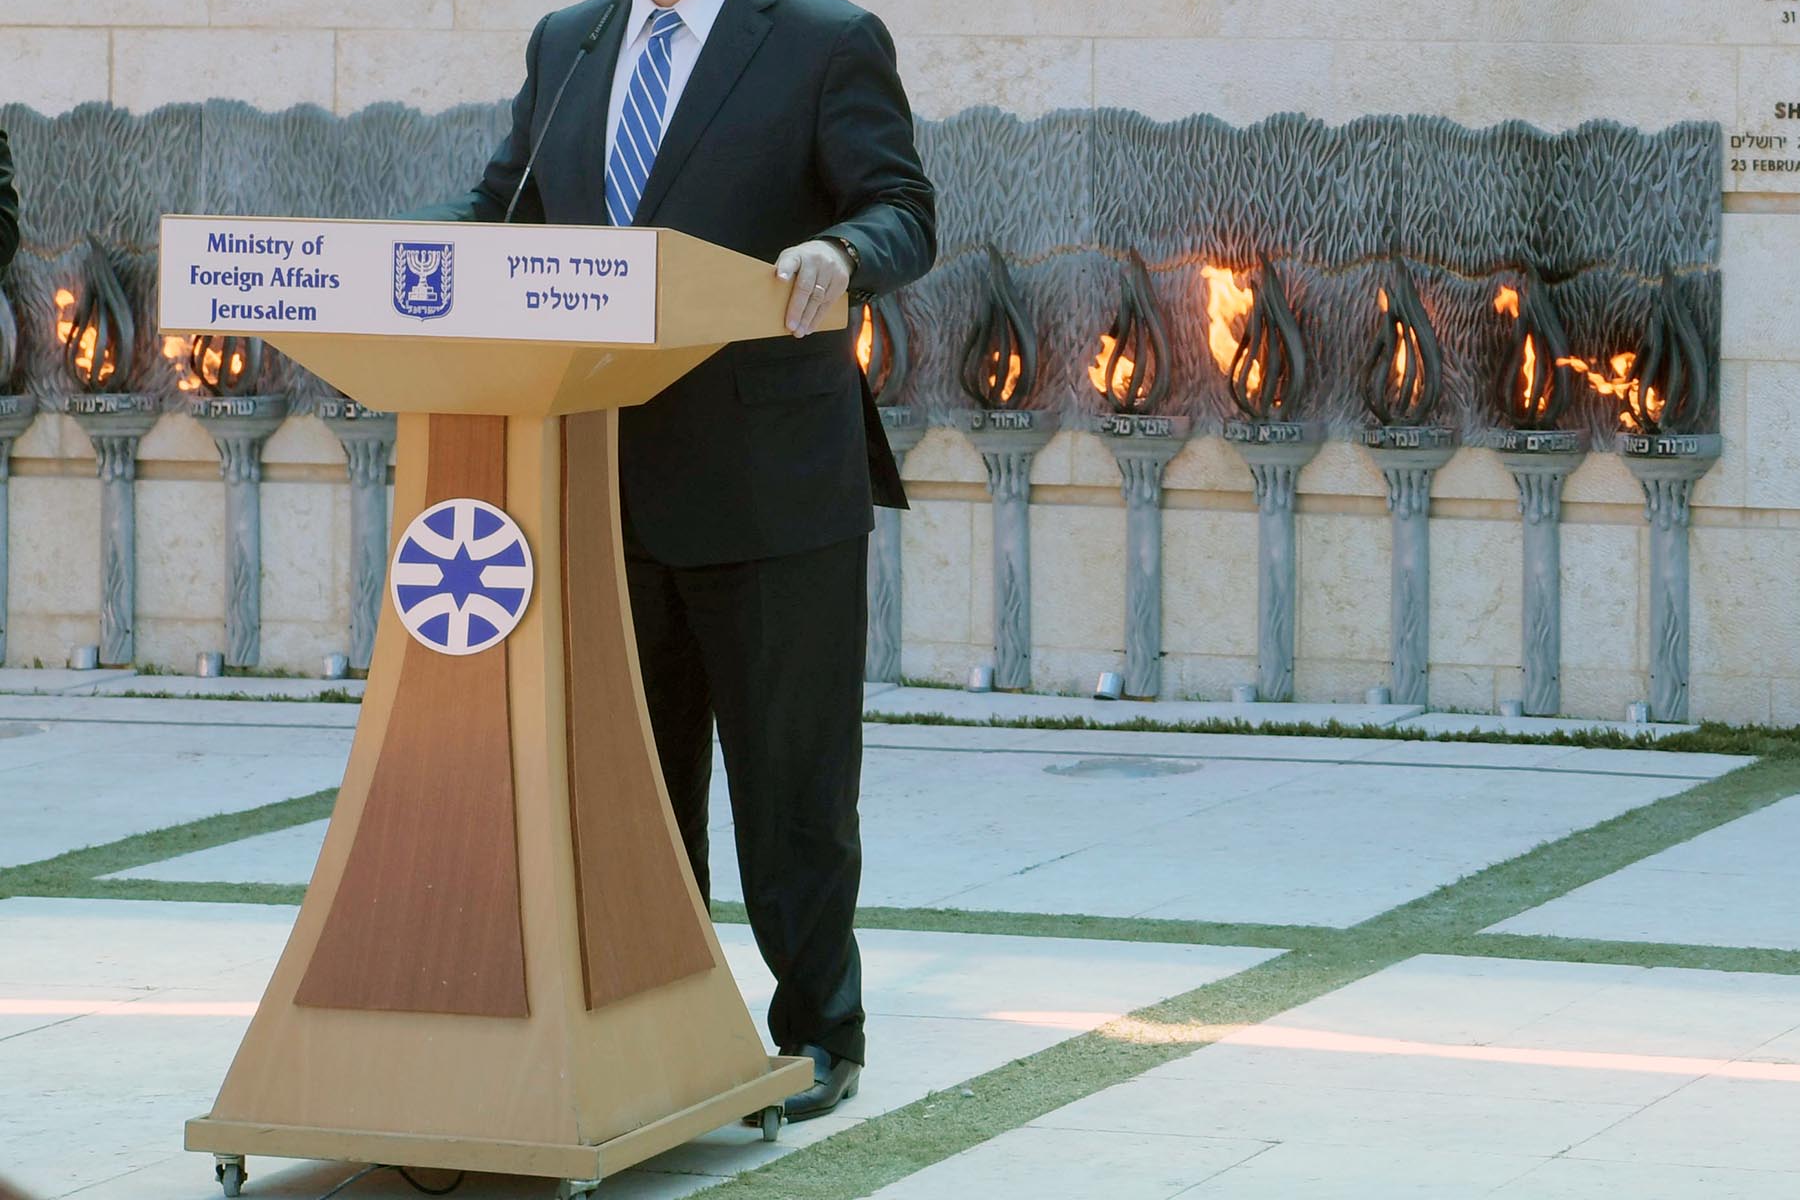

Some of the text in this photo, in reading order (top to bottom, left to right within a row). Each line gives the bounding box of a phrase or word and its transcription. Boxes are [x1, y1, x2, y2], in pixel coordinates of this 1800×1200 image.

[1781, 10, 1796, 25] 31
[1731, 158, 1747, 172] 23
[207, 232, 325, 261] Ministry of
[190, 264, 340, 294] Foreign Affairs
[507, 255, 629, 279] משרד החוץ
[525, 285, 610, 313] ירושלים
[210, 298, 318, 325] Jerusalem
[990, 412, 1031, 429] אהוד
[1658, 438, 1698, 454] עדנה
